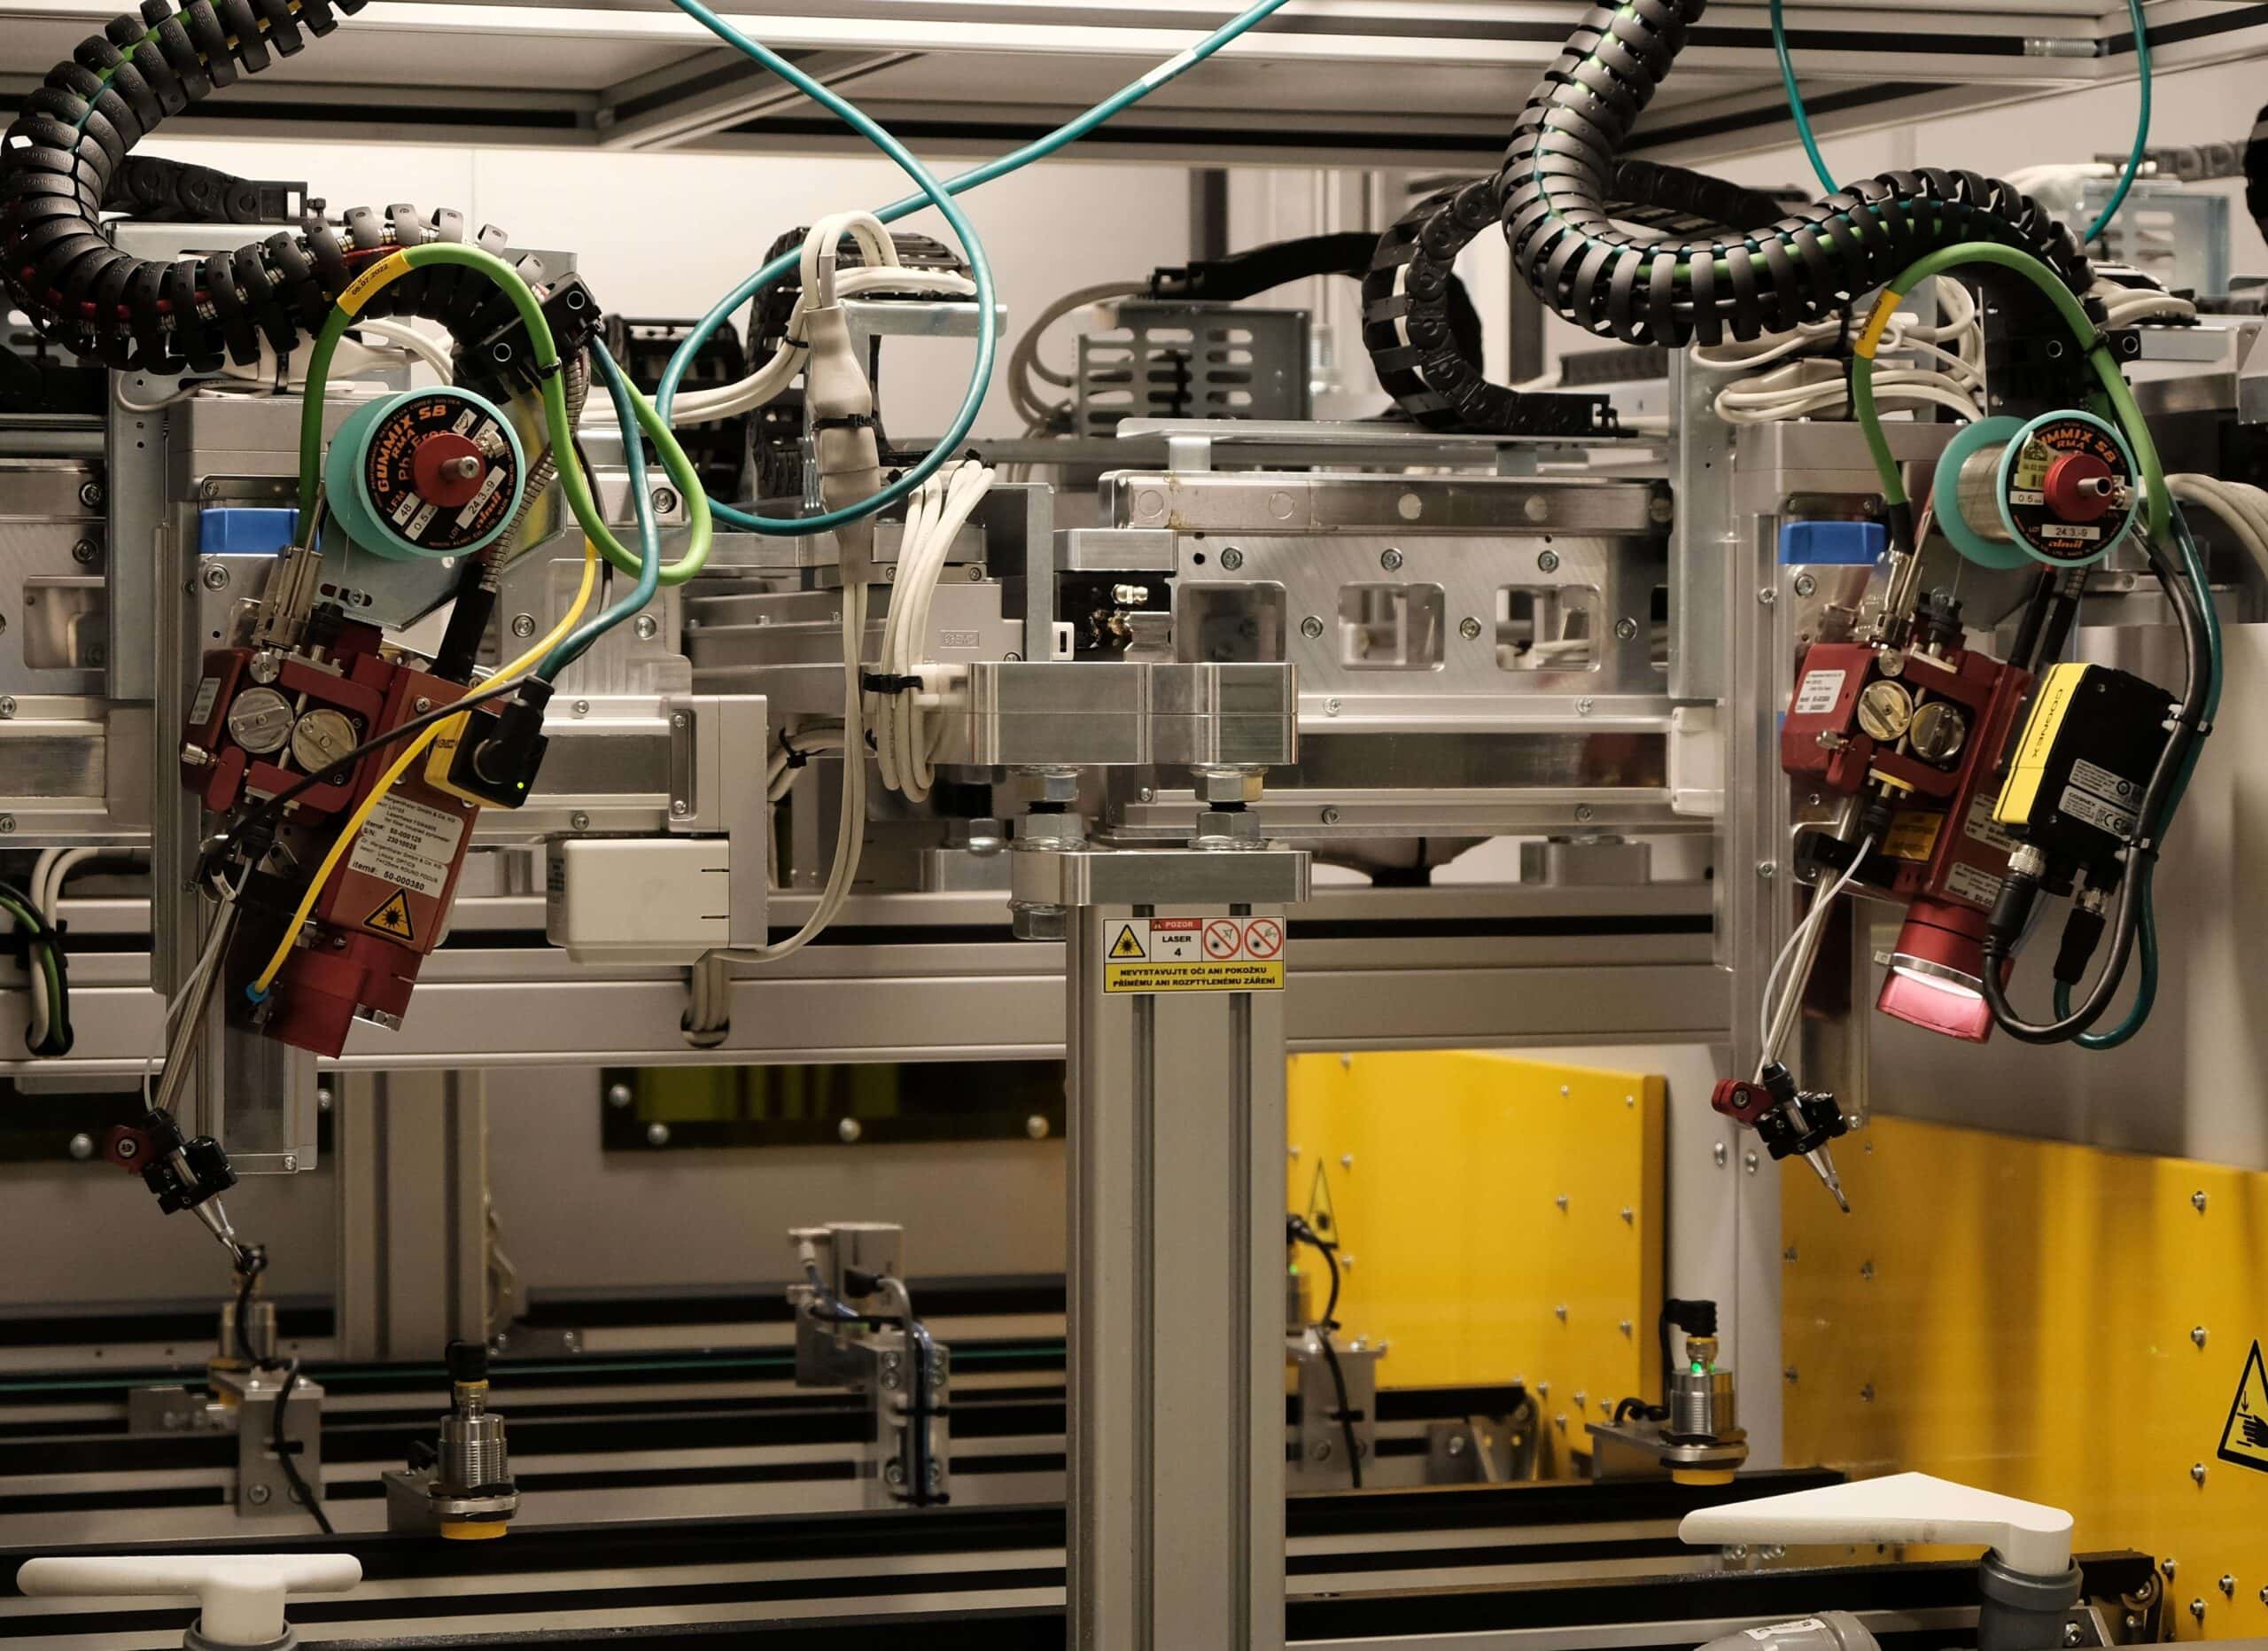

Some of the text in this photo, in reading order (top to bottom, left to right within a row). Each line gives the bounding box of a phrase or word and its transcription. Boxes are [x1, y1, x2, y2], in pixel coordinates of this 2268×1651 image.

[377, 404, 447, 493] GUMMIX SB
[392, 429, 416, 459] RMA
[2093, 440, 2117, 463] SB
[400, 503, 412, 518] 48
[2032, 689, 2063, 759] COGNEX
[1120, 967, 1188, 976] NEVYSTAVUJTE
[1190, 966, 1206, 975] OČI
[1225, 964, 1267, 974] POKOŽKU
